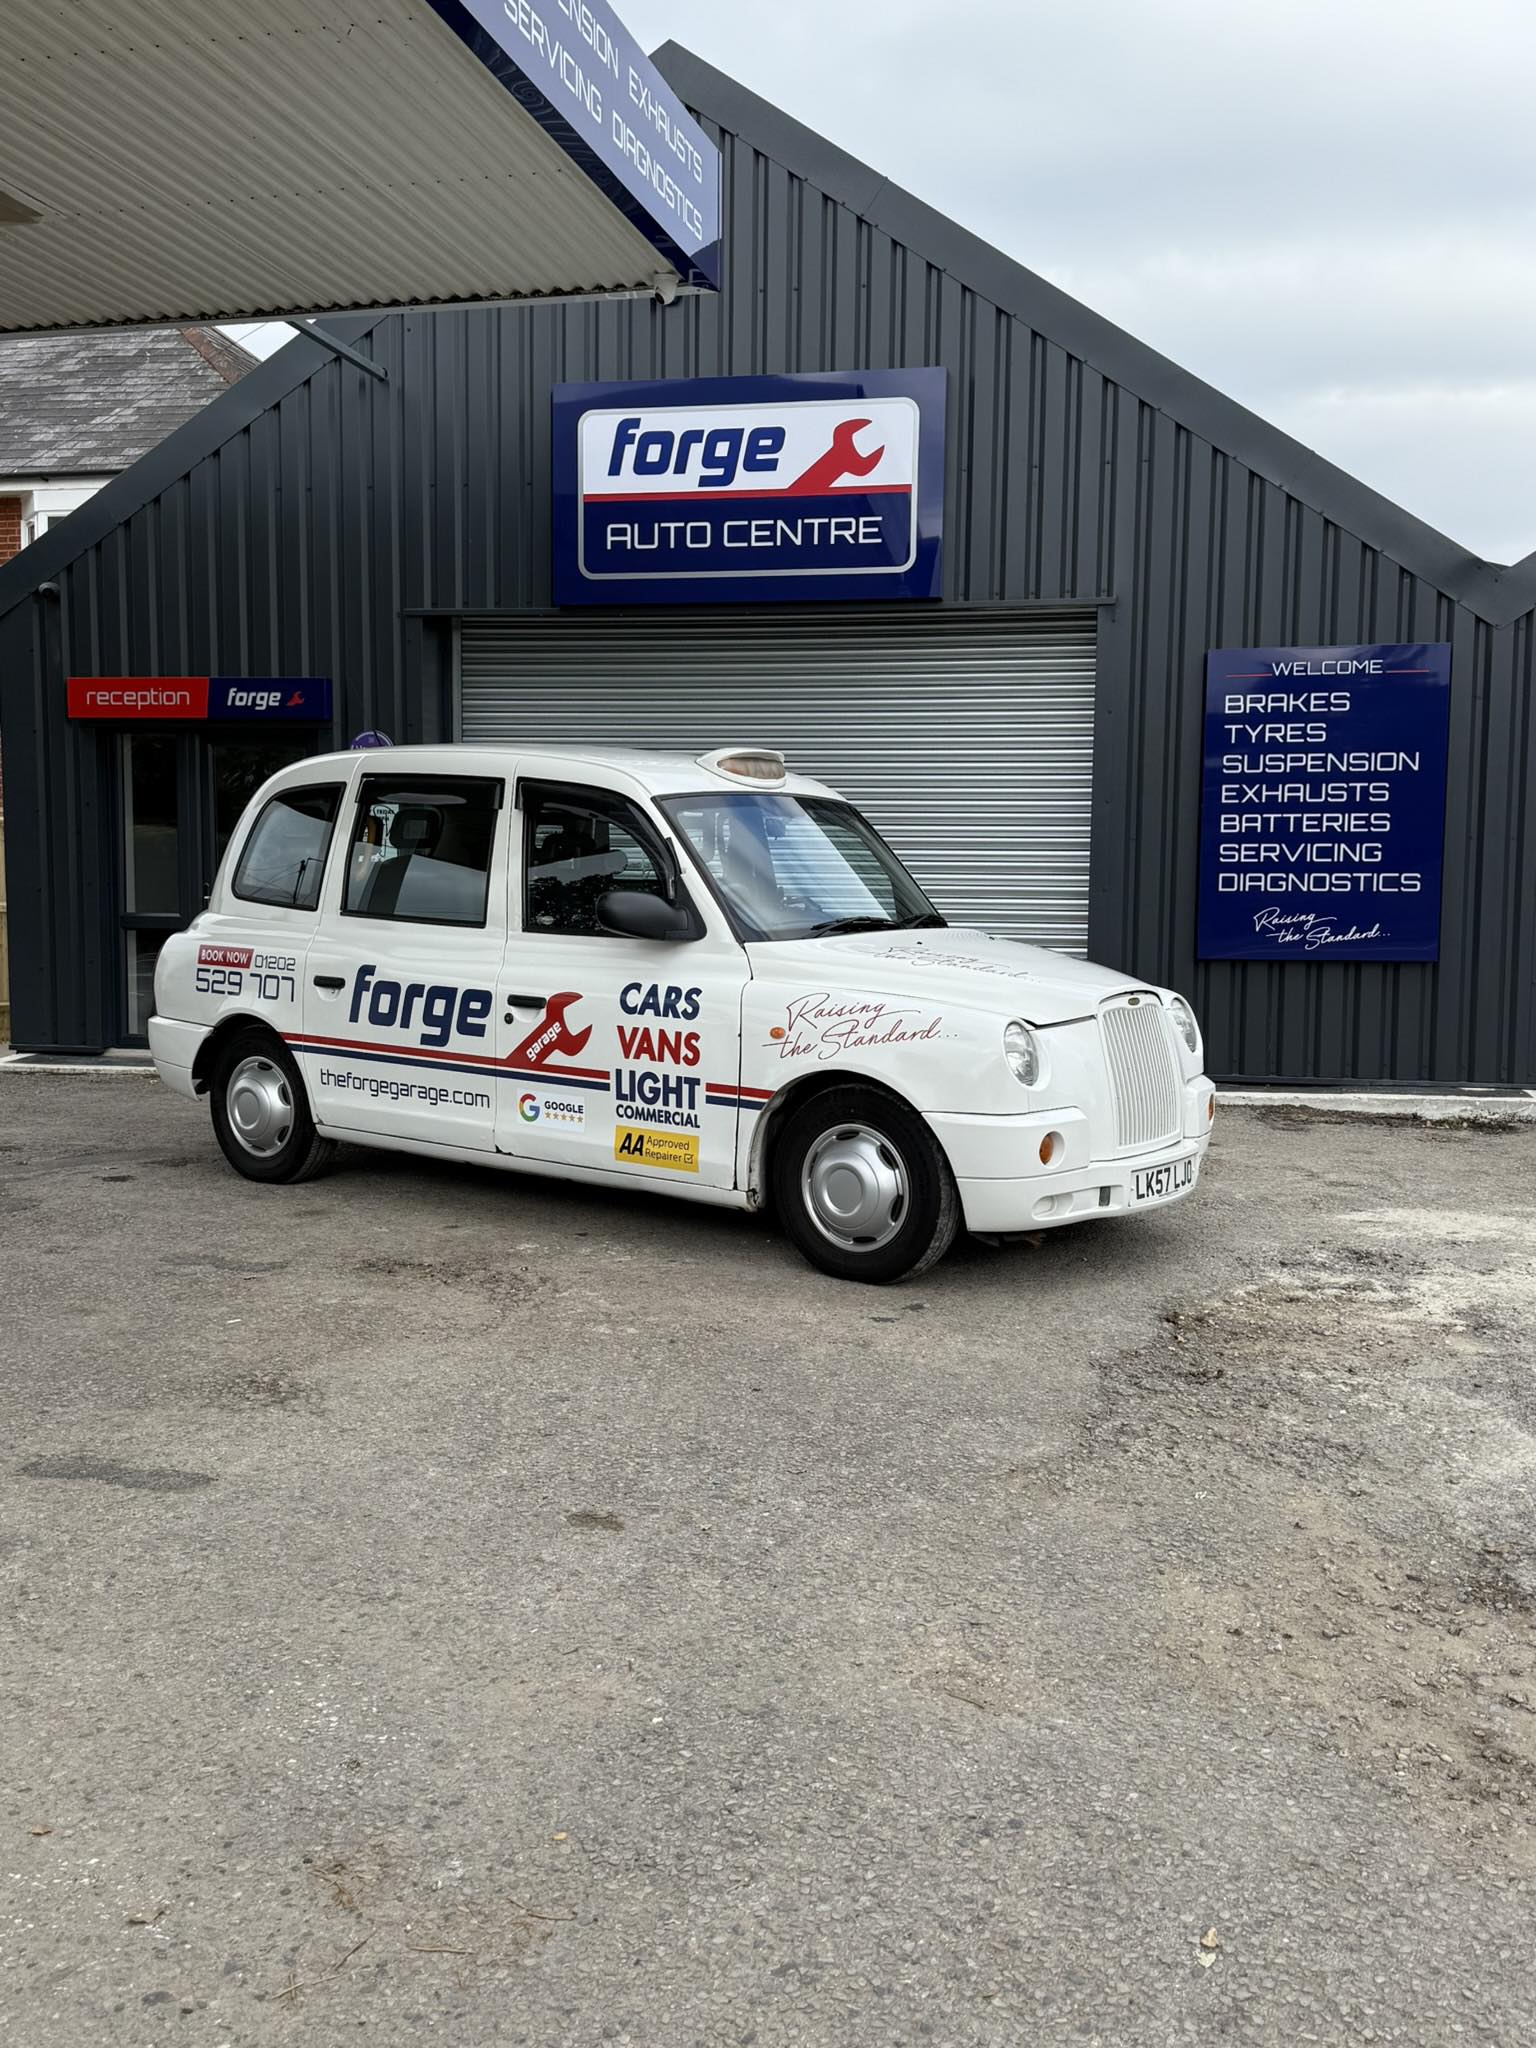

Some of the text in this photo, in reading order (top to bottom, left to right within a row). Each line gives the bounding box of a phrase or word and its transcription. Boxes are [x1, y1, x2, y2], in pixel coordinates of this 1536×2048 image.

[558, 0, 702, 184] NSION EXHAUSTS
[612, 110, 702, 240] DIAGNOSTICS
[607, 417, 786, 488] forge
[606, 516, 883, 550] AUTO CENTRE
[1272, 660, 1383, 676] WELCOME
[86, 688, 281, 710] reception forge
[1224, 692, 1351, 714] BRAKES
[1224, 723, 1327, 744] TYRES
[1222, 752, 1420, 773] SUSPENSION
[1221, 783, 1390, 804] EXHAUSTS
[1220, 813, 1391, 833] BATTERIES
[1219, 843, 1382, 862] SERVICING
[1218, 873, 1421, 892] DIAGNOSTICS
[1253, 907, 1337, 931] Raising
[1266, 927, 1304, 943] the
[201, 949, 249, 964] BOOK NOW
[255, 954, 296, 971] 01202
[196, 968, 295, 1002] 529 707
[349, 964, 493, 1047] forge
[619, 982, 703, 1021] CARS
[786, 993, 921, 1030] Raising
[526, 1021, 562, 1062] garage
[616, 1025, 701, 1066] VANS
[762, 1031, 818, 1059] the
[320, 1068, 490, 1108] theforgegarage.com
[615, 1068, 701, 1110] LIGHT
[519, 1093, 584, 1122] G GOOGLE
[616, 1104, 700, 1128] COMMERCIAL
[619, 1133, 645, 1156] AA
[645, 1148, 682, 1162] Repairer
[646, 1136, 690, 1150] Approved
[1136, 1167, 1171, 1200] LK57
